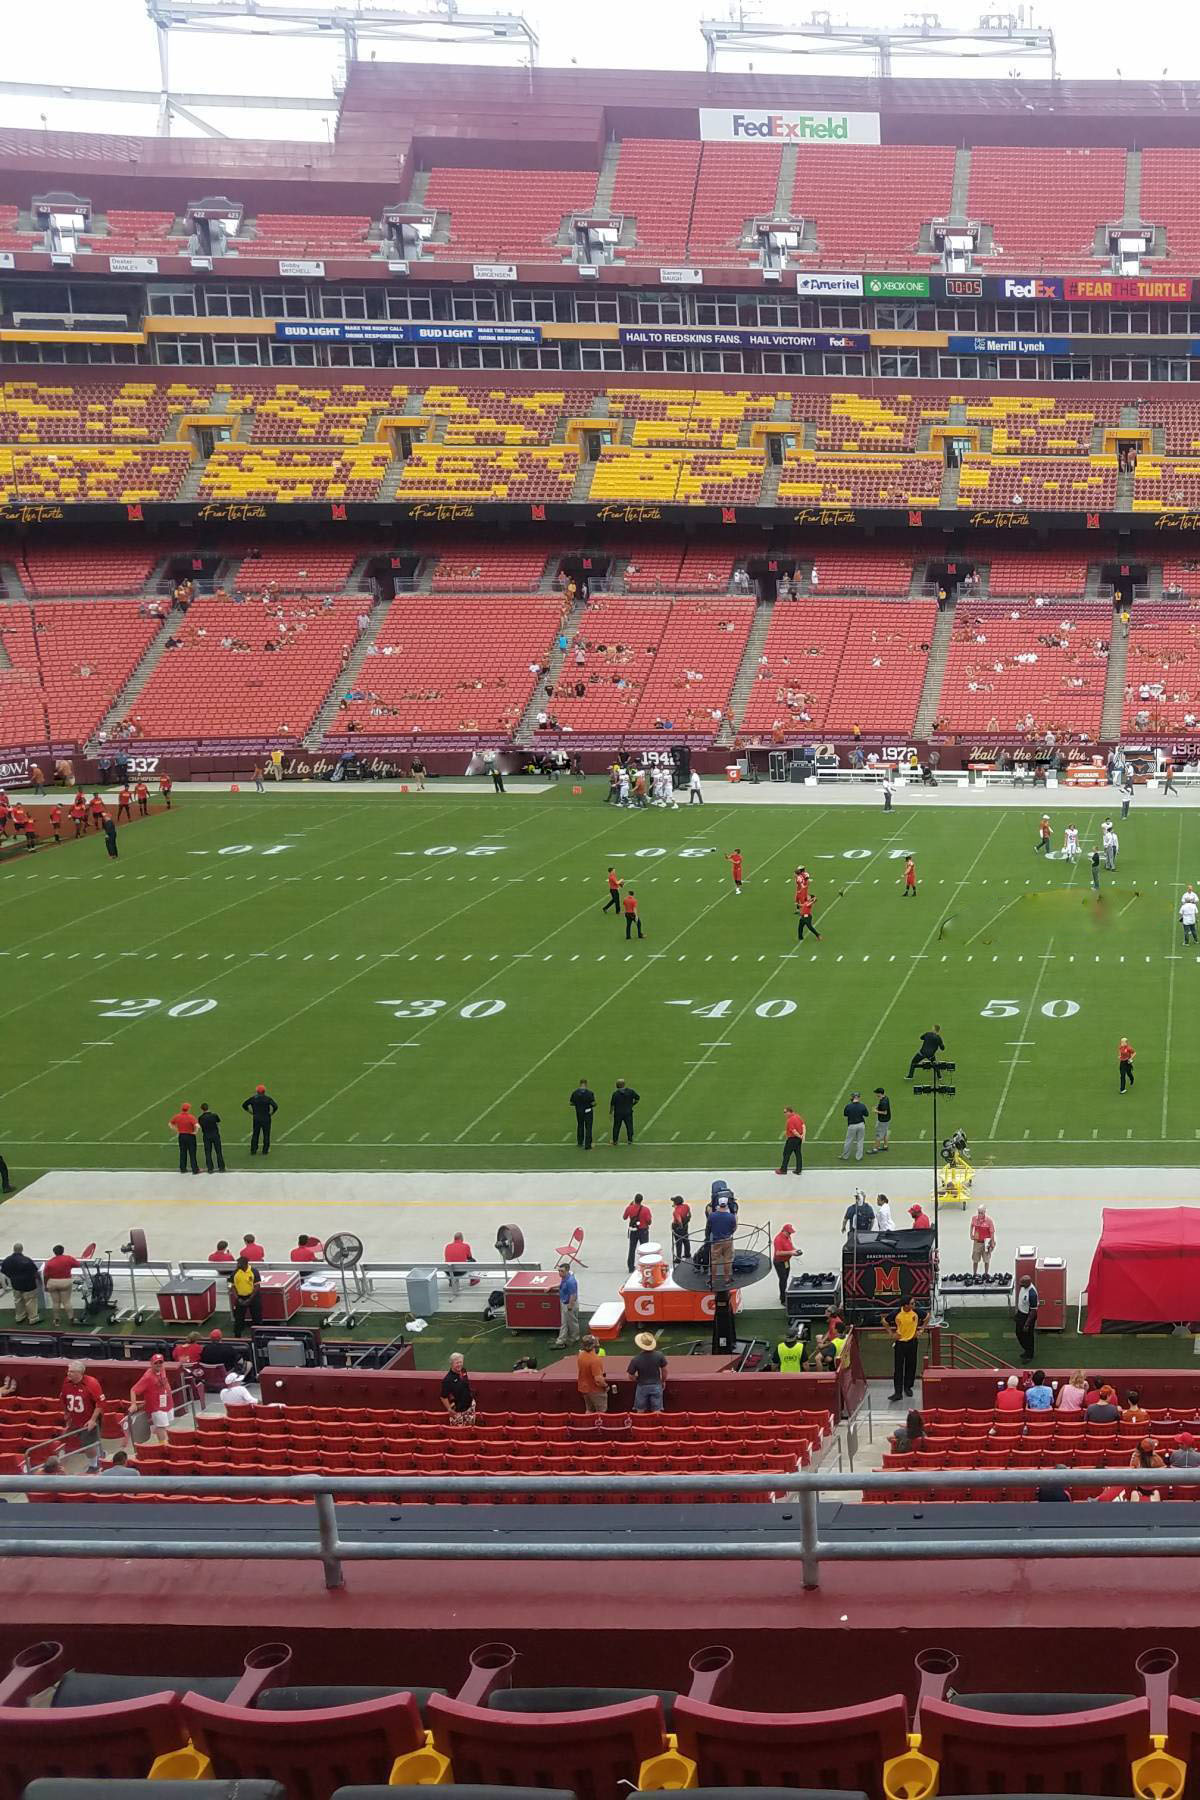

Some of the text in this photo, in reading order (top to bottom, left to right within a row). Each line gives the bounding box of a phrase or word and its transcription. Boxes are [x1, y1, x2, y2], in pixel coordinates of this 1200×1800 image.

[733, 115, 848, 139] FedExField
[810, 279, 860, 290] Ameritel
[905, 283, 925, 291] ONE
[1004, 279, 1056, 298] FedEx
[285, 326, 341, 336] BUD LIGHT
[420, 328, 474, 338] BUD LIGHT
[626, 333, 816, 346] HAIL TO REDSKINS FANS. HAIL VICTORY!
[987, 340, 1045, 352] Merrill Lynch
[643, 1268, 651, 1278] G
[874, 1266, 901, 1293] M
[310, 1292, 319, 1301] G
[634, 1295, 655, 1316] G
[66, 1394, 84, 1413] 33
